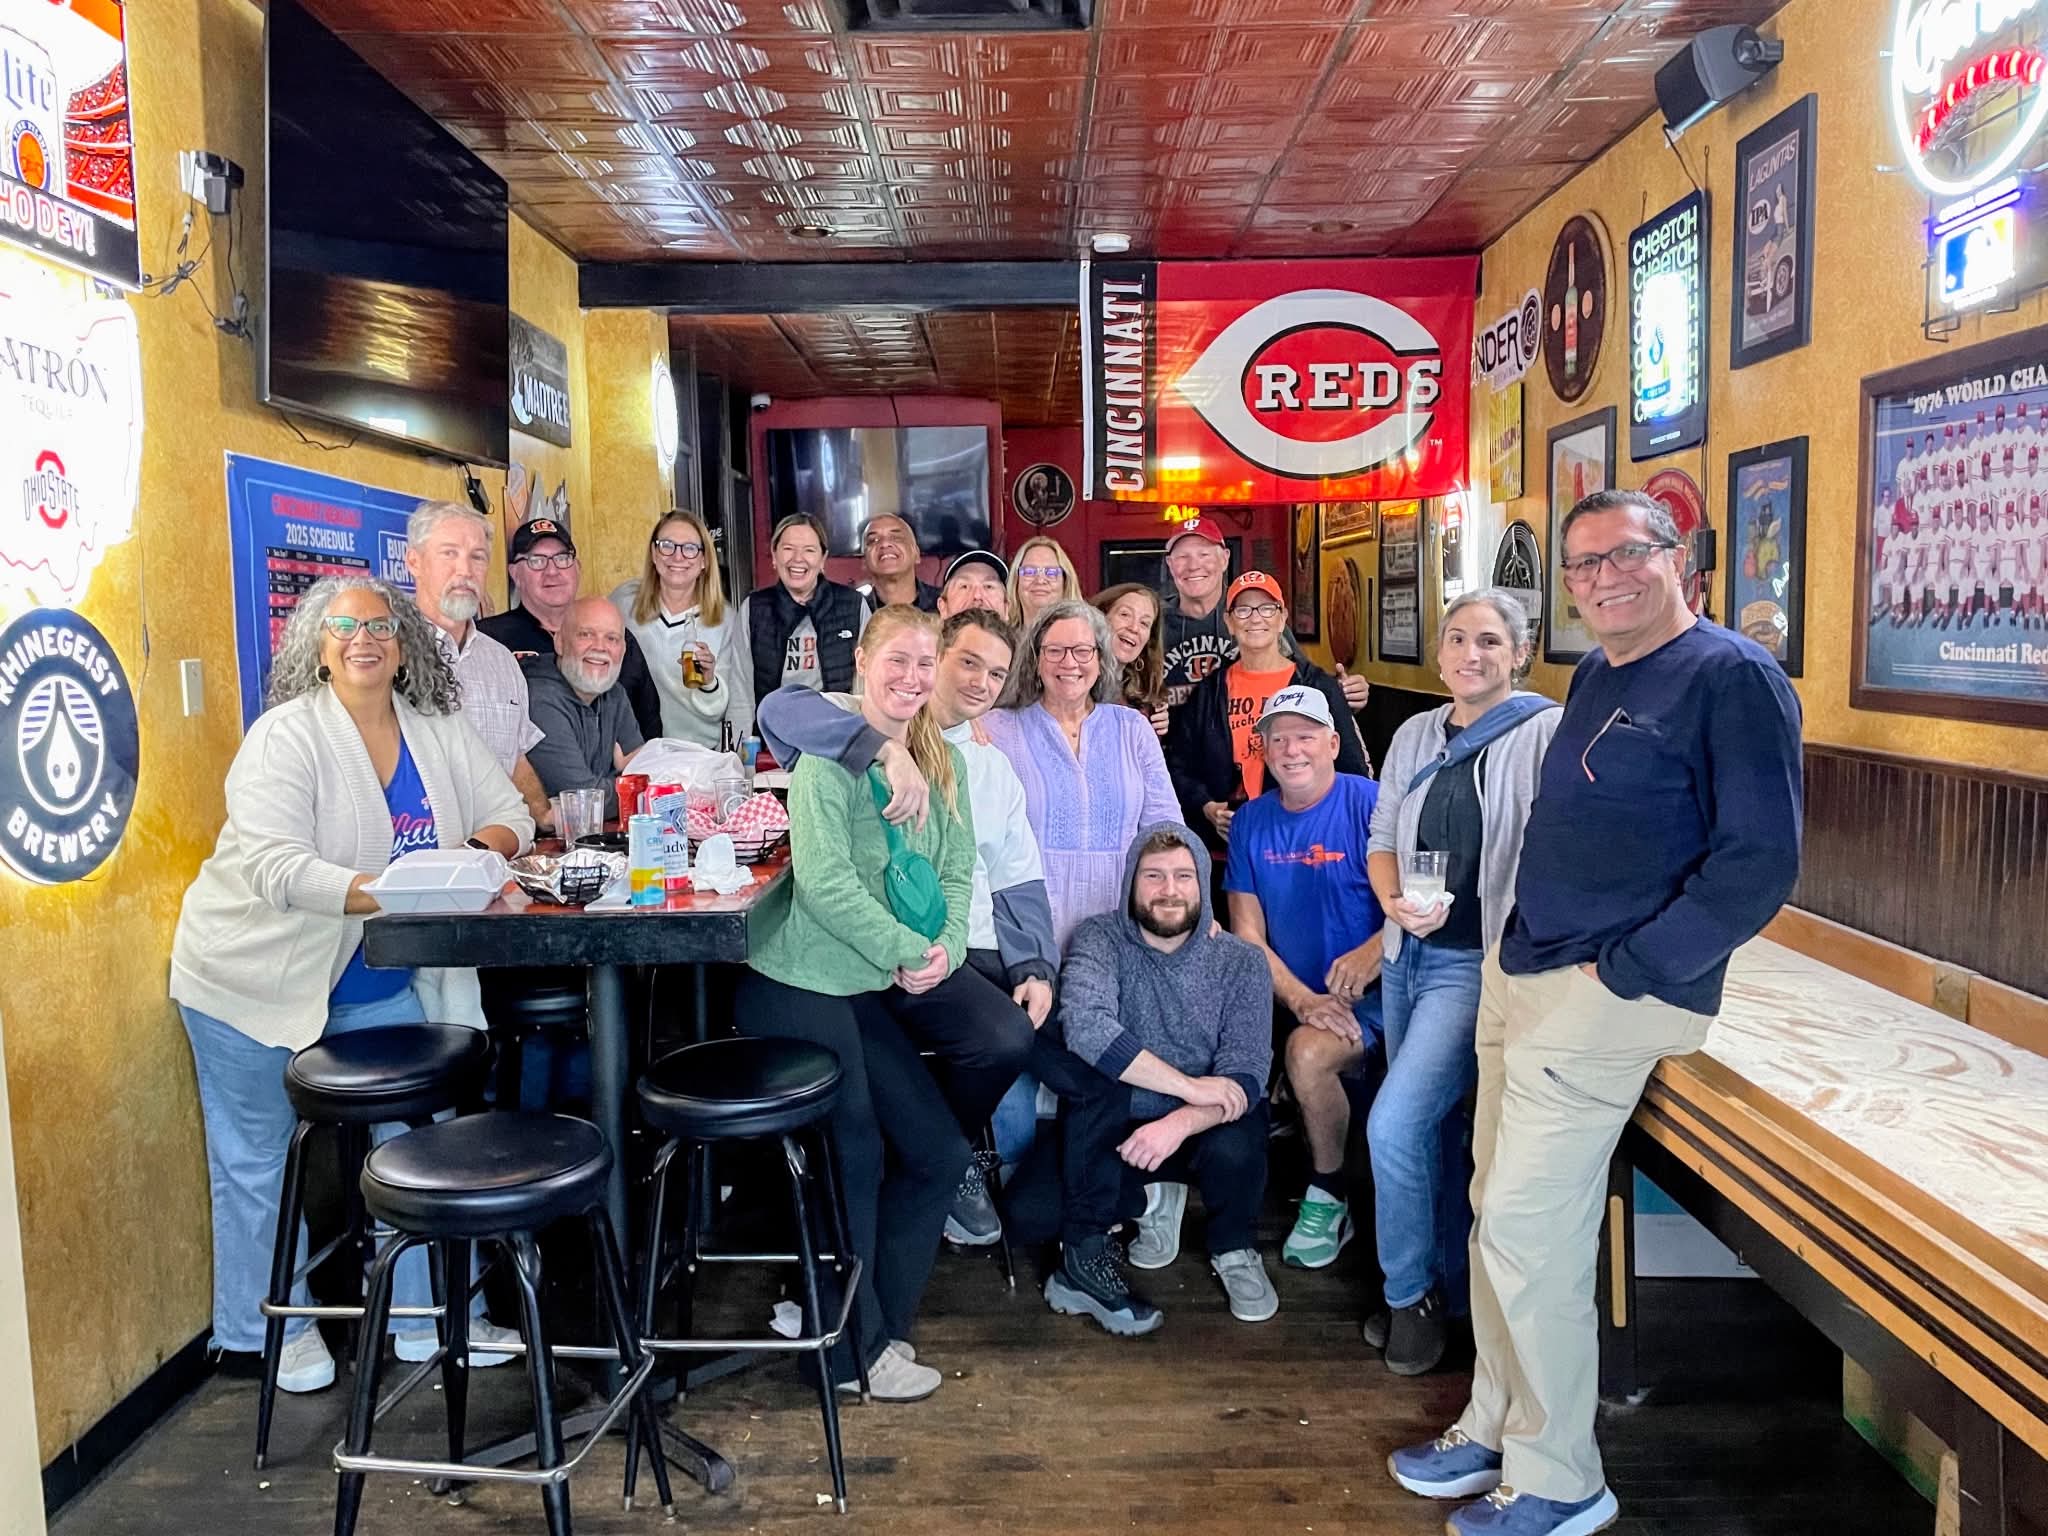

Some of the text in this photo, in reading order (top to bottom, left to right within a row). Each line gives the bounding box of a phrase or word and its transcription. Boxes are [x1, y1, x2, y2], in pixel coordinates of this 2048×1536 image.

[4, 49, 51, 111] Lite
[1749, 139, 1796, 193] LAGUNITAS
[1751, 203, 1769, 227] IPA
[524, 374, 569, 428] MADTREE
[1103, 280, 1145, 492] CINCINNATI
[1254, 360, 1442, 411] REDS
[1945, 374, 2006, 406] WORLD
[2010, 364, 2048, 392] CHA
[286, 522, 355, 552] 2025 SCHEDULE
[0, 627, 120, 706] RHINEGEIST
[1939, 641, 2017, 664] Cincinnati
[1273, 690, 1305, 707] Cincy
[7, 792, 120, 865] BREWERY
